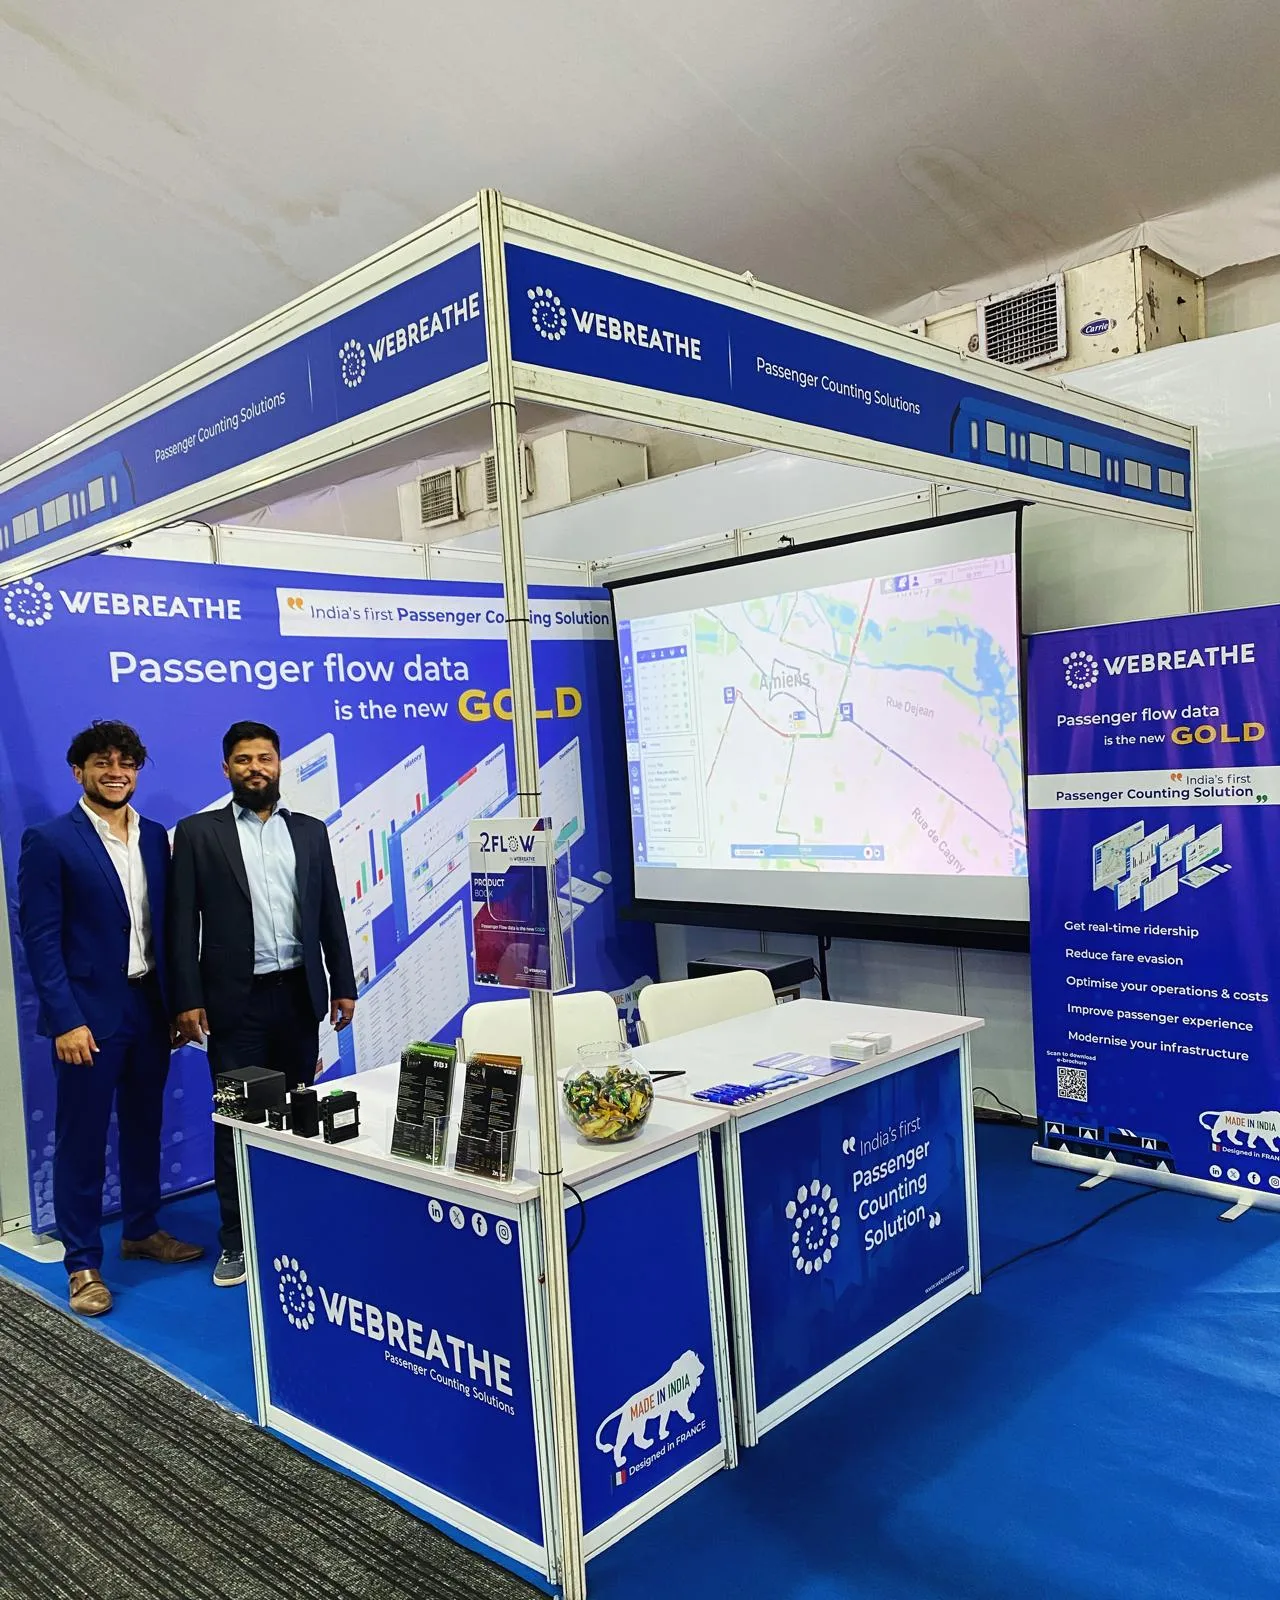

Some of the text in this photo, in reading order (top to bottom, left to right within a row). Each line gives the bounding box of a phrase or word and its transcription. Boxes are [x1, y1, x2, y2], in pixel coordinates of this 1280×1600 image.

[368, 292, 480, 364] WEBREATHE
[571, 307, 701, 361] WEBREATHE
[1086, 322, 1109, 334] Carrie
[756, 356, 921, 415] Passenger Counting Solutions
[154, 391, 286, 464] Passenger Counting Solutions
[58, 590, 242, 620] WEBREATHE
[310, 605, 610, 627] India's first Passenger Coing Solution
[109, 651, 470, 690] Passenger flow data
[1103, 643, 1255, 676] WEBREATHE
[760, 671, 810, 691] Amiens
[334, 700, 353, 721] is
[358, 699, 397, 720] the
[403, 702, 449, 719] new
[1057, 705, 1219, 727] Passenger flow data
[1104, 722, 1265, 746] is the new GOLD
[1056, 786, 1253, 802] Passenger Counting Solution
[1186, 774, 1251, 786] India's first
[1064, 921, 1200, 939] Get real-time ridership
[1065, 948, 1184, 966] Reduce fare evasion
[1066, 976, 1269, 1002] Optimise your operations & costs
[1067, 1003, 1254, 1032] Improve passenger experience
[1068, 1031, 1249, 1061] Modernise your infrastructure
[1069, 1053, 1097, 1061] download
[1056, 1057, 1088, 1066] e-brochure
[860, 1116, 921, 1156] India's first
[1225, 1116, 1276, 1132] MADE IN INDIA
[853, 1141, 930, 1192] Passenger
[1222, 1146, 1253, 1157] Designed
[1261, 1153, 1280, 1161] FRAN
[858, 1173, 928, 1220] Counting
[864, 1205, 925, 1251] Solution
[318, 1286, 513, 1397] WEBREATHE
[385, 1350, 515, 1416] Passenger Counting Solutions
[630, 1373, 690, 1421] MADE IN INDIA
[629, 1420, 706, 1476] Designed in FRANCE
